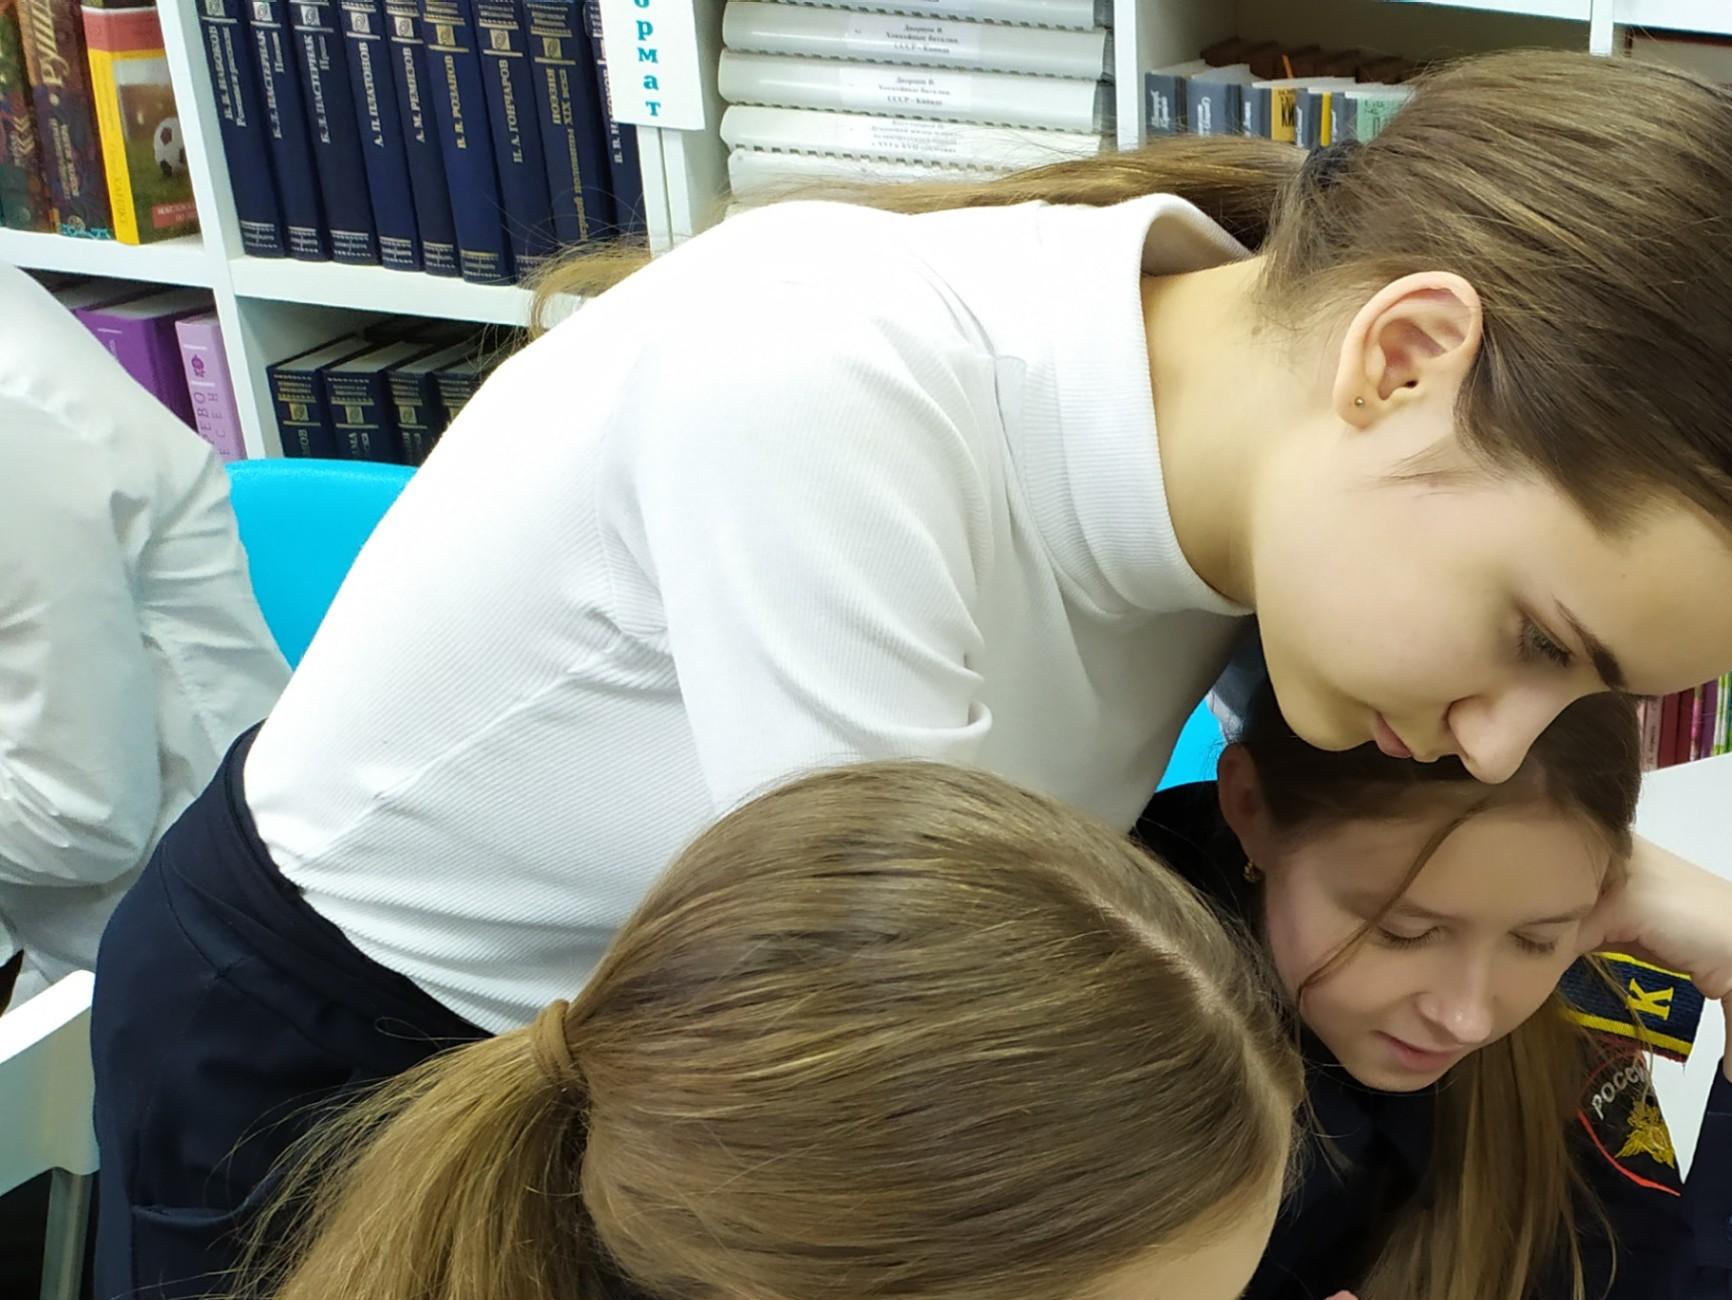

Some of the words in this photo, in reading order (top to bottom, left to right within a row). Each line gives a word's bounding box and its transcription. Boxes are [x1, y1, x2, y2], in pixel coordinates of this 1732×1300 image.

[256, 29, 277, 110] ПАСТЕРНАК
[303, 34, 325, 114] ПАСТЕРНАК
[358, 41, 378, 116] ПЛАТОНОВ
[402, 46, 420, 111] РЕМИЗОВ
[443, 54, 461, 119] РОЗАНОВ
[498, 58, 518, 133] ГОНЧАРОВ
[370, 118, 381, 132] П.
[373, 134, 383, 147] А.
[412, 112, 423, 128] М.
[415, 130, 425, 143] А.
[510, 134, 520, 146] А.
[1627, 977, 1674, 1020] К
